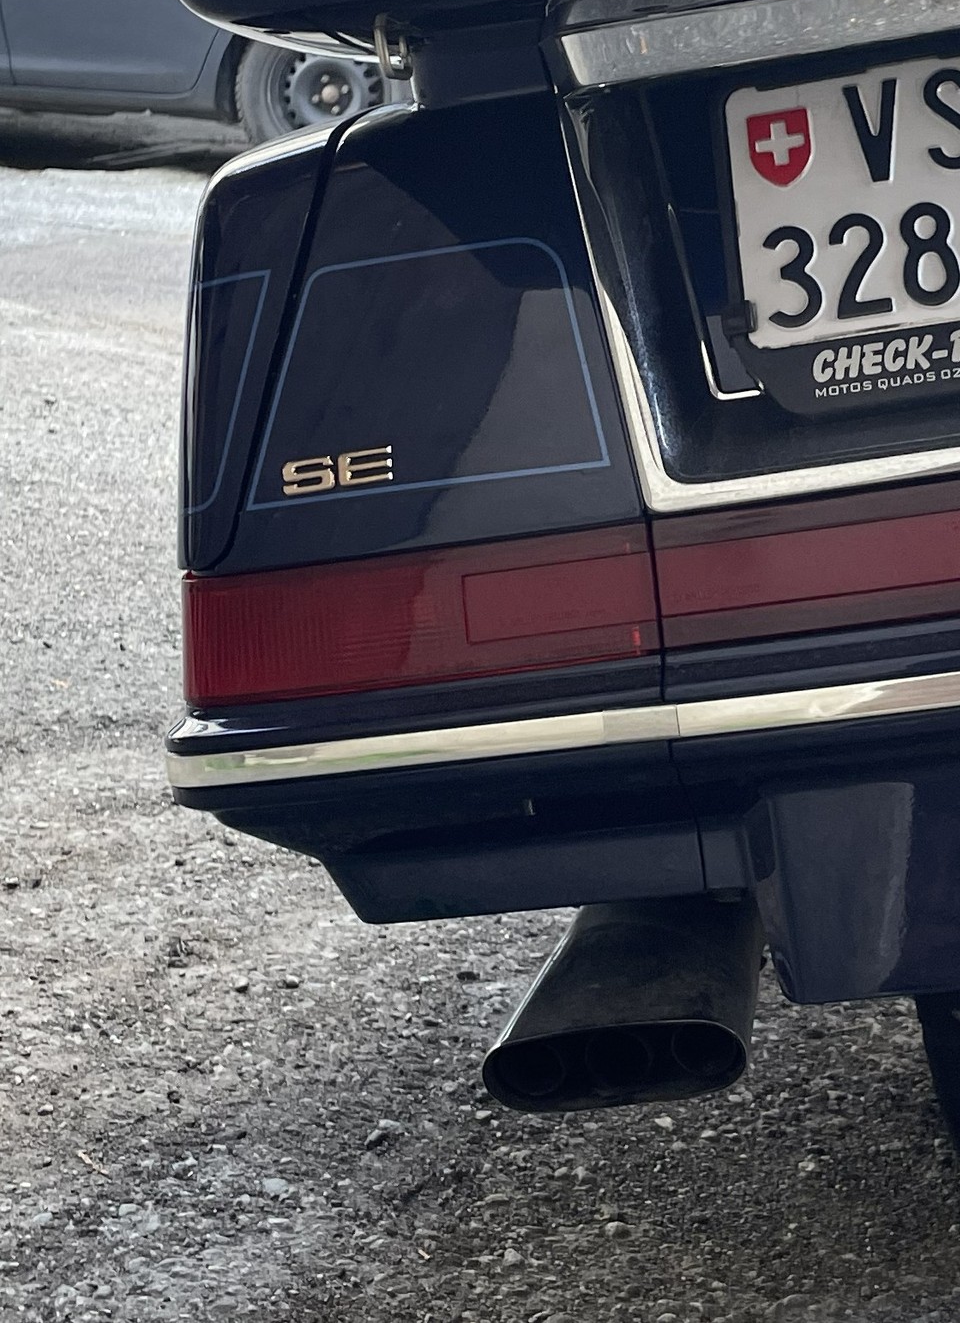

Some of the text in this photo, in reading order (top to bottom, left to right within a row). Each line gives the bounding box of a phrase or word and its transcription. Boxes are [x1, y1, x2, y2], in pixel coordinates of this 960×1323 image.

[815, 380, 873, 398] MOTOS
[877, 371, 937, 390] QUADS
[281, 445, 394, 496] SE
